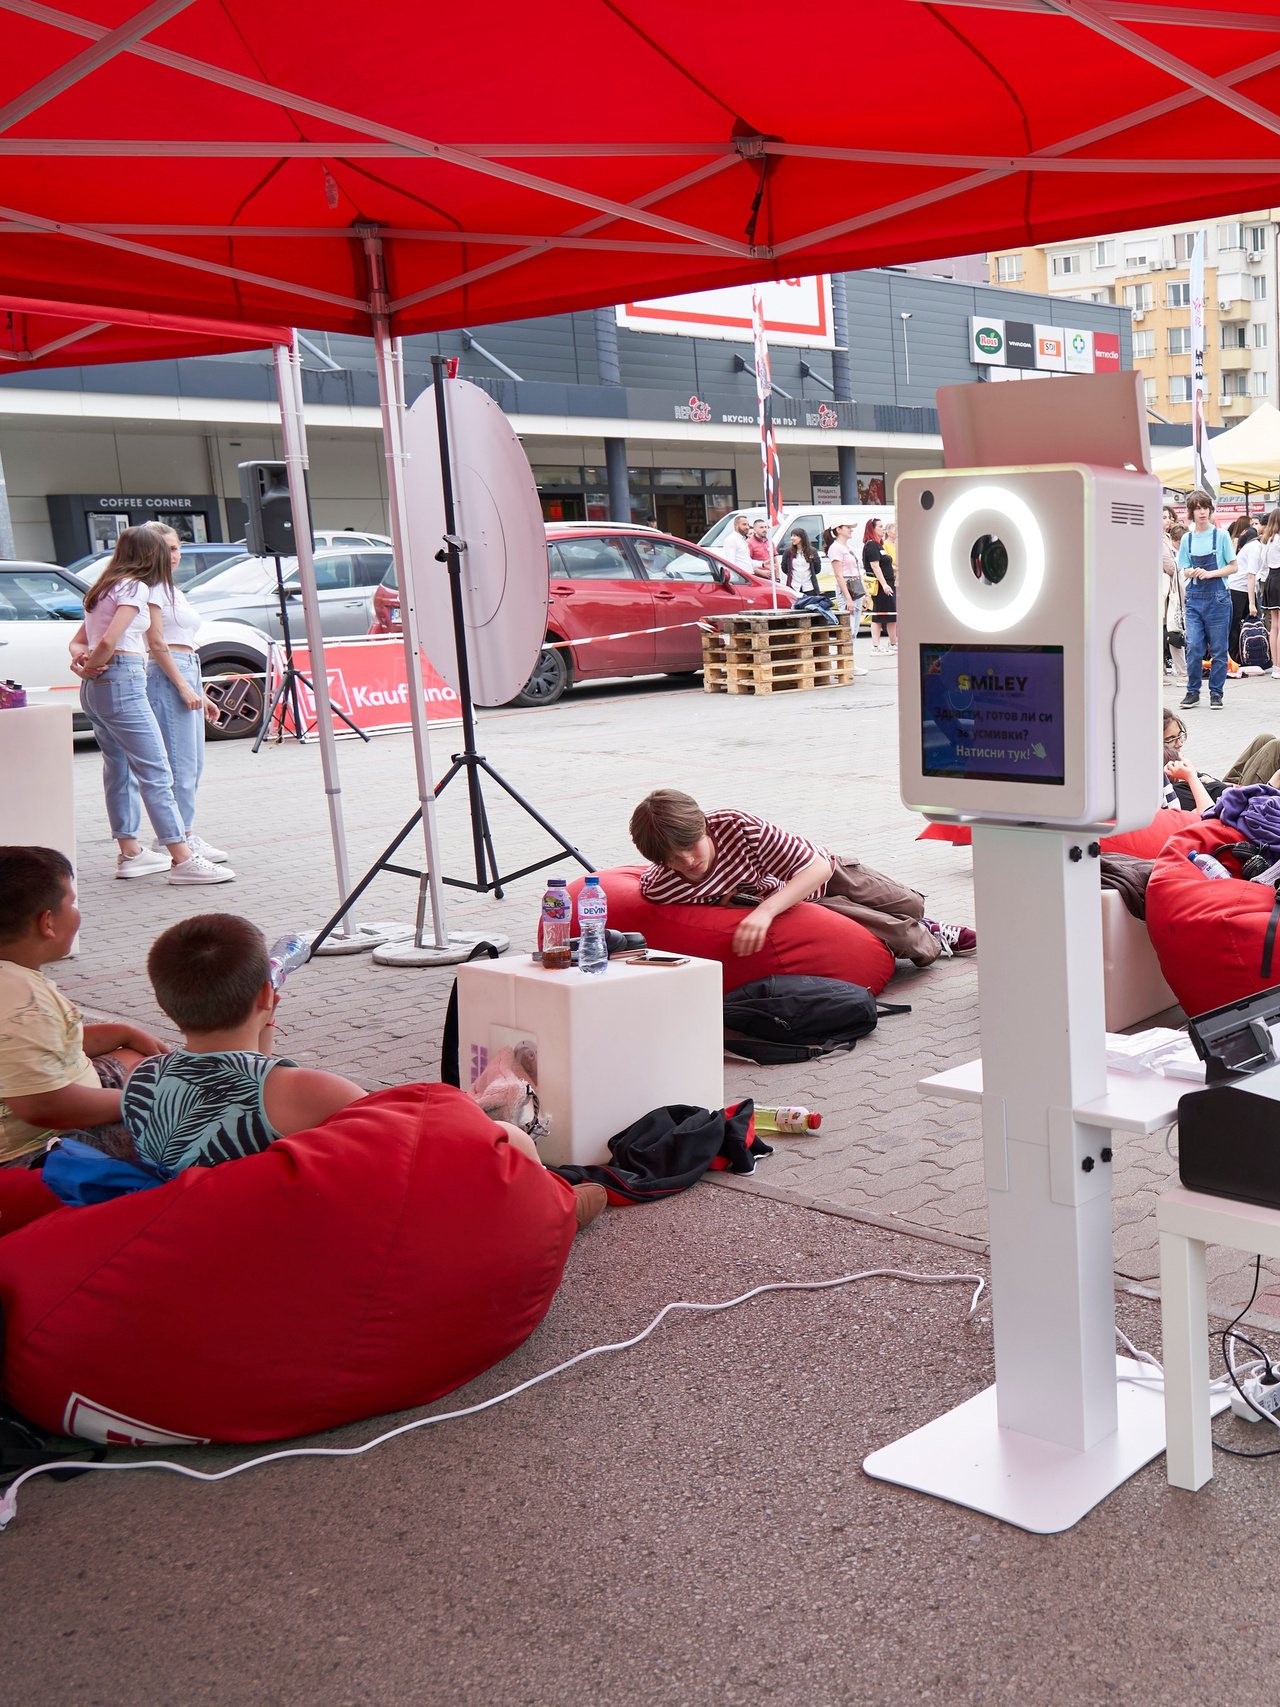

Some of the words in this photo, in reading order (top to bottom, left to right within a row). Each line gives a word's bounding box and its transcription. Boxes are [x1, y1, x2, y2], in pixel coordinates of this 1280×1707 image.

[722, 414, 754, 424] ВКУСНО
[100, 498, 143, 507] COFFEE
[145, 498, 192, 507] CORNER
[986, 710, 1018, 721] готов
[1021, 712, 1036, 722] ли
[1039, 713, 1053, 722] си
[973, 729, 1029, 741] усмивки?
[956, 745, 1005, 758] Натисни
[1007, 749, 1031, 762] тук!
[583, 906, 606, 915] DEVIN
